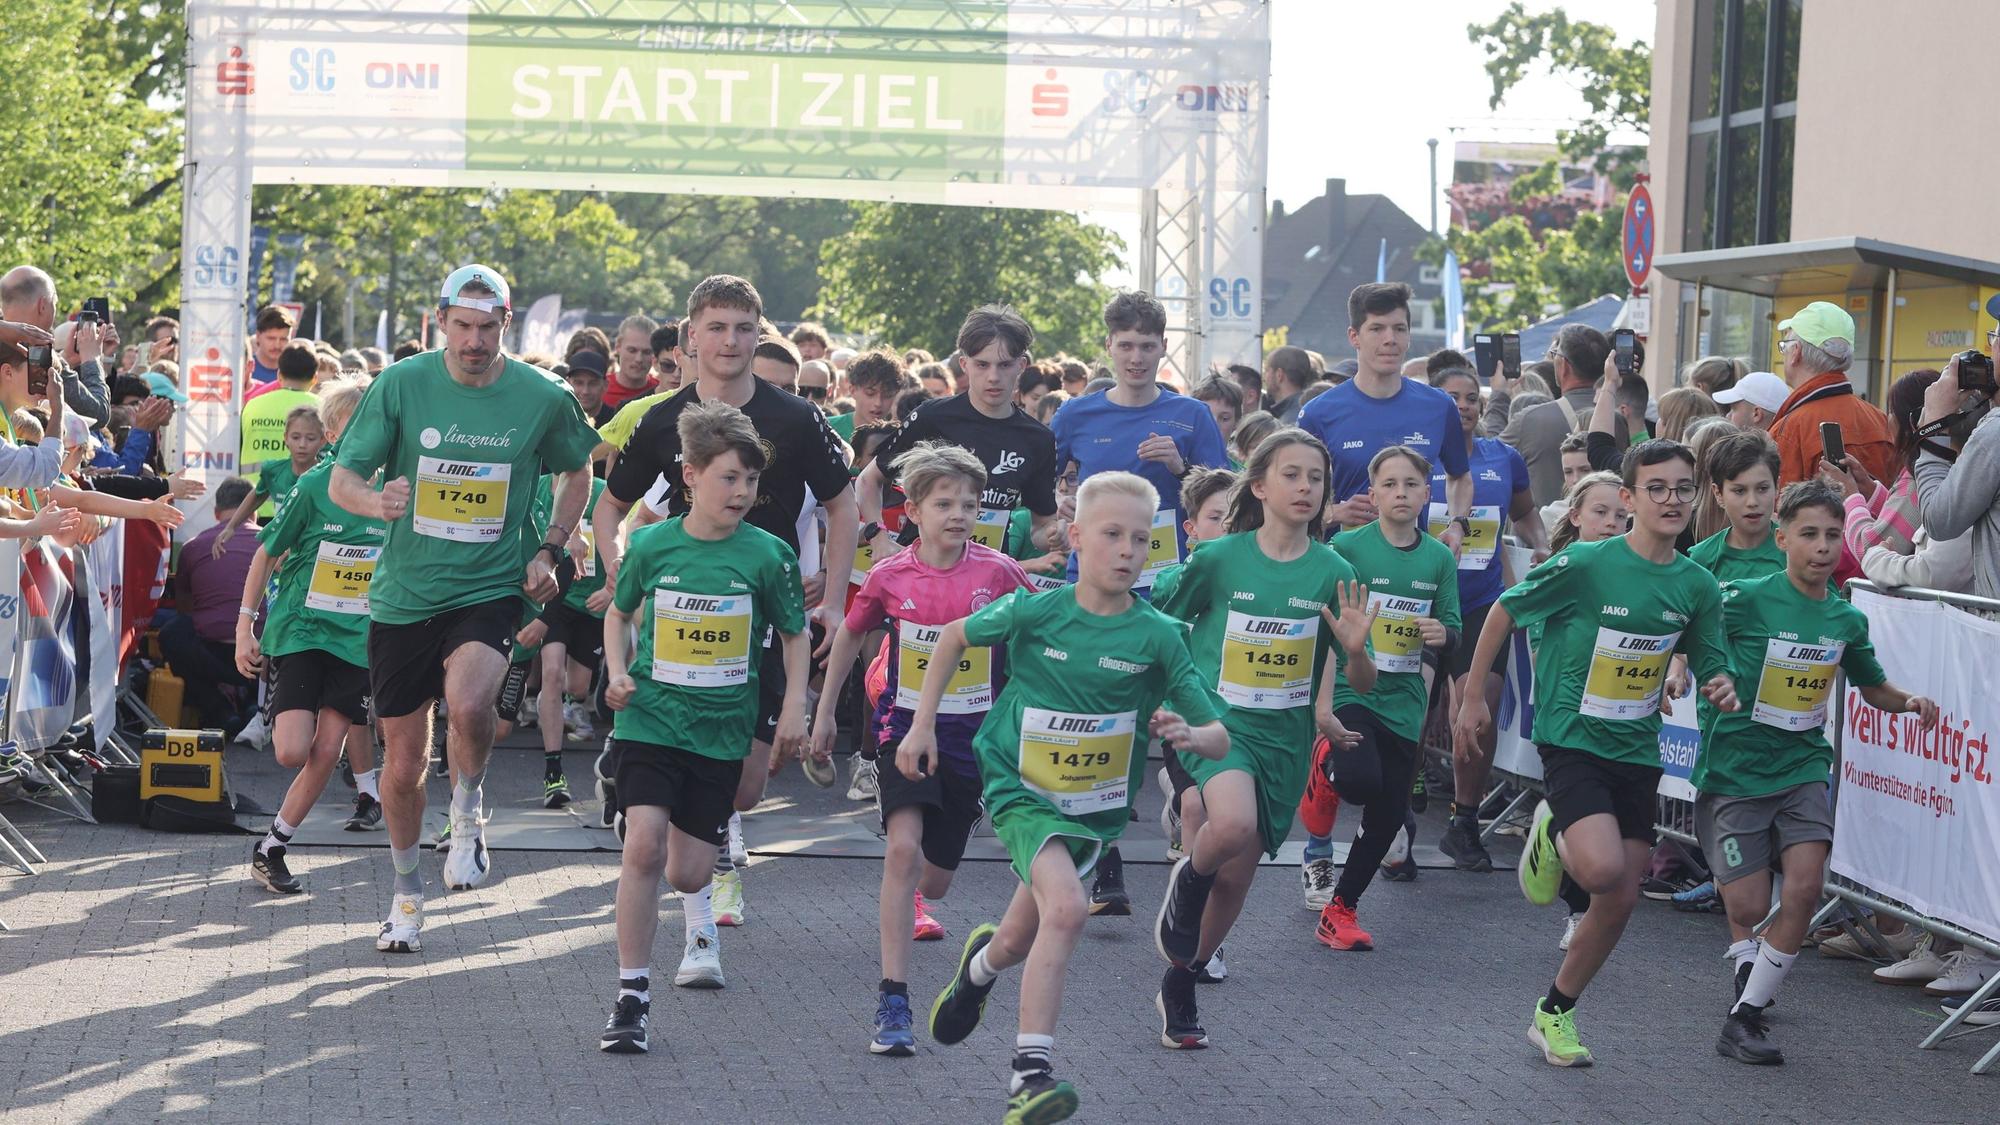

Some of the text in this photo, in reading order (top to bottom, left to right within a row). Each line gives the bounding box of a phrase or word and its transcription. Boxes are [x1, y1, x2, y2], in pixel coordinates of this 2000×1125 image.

[638, 22, 841, 54] LINDLAR LÄUFT
[289, 47, 336, 92] SC
[365, 62, 439, 89] ONI
[511, 63, 749, 124] START
[800, 72, 963, 130] ZIEL
[1209, 277, 1251, 317] SC
[444, 423, 517, 448] linzenich
[1920, 422, 1942, 436] Canon
[1342, 441, 1364, 449] JAKO
[436, 463, 478, 477] LANG
[437, 489, 487, 504] 1740
[323, 523, 343, 532] JAKO
[336, 547, 369, 558] LANG
[333, 570, 372, 582] 1450
[659, 575, 680, 584] JAKO
[1371, 577, 1390, 585] JAKO
[1232, 591, 1255, 601] JAKO
[674, 596, 719, 612] LANG
[1385, 598, 1420, 613] LANG
[1601, 605, 1629, 617] JAKO
[1244, 620, 1290, 635] LANG
[1383, 623, 1421, 638] 1432
[675, 628, 731, 643] 1468
[1777, 631, 1799, 640] JAKO
[1618, 636, 1660, 651] LANG
[690, 648, 713, 656] Jonas
[1043, 647, 1068, 661] JAKO
[1244, 651, 1299, 666] 1436
[1787, 646, 1828, 661] LANG
[916, 658, 971, 672] 29
[1615, 665, 1660, 679] 1444
[1255, 671, 1286, 679] Tillmann
[1785, 676, 1828, 690] 1443
[1047, 715, 1100, 733] LANG
[168, 741, 194, 758] D8
[1658, 734, 1698, 769] elstahl
[1048, 751, 1111, 767] 1479
[1059, 773, 1097, 782] Johannes
[1107, 790, 1126, 801] ONI
[1724, 837, 1743, 867] 8
